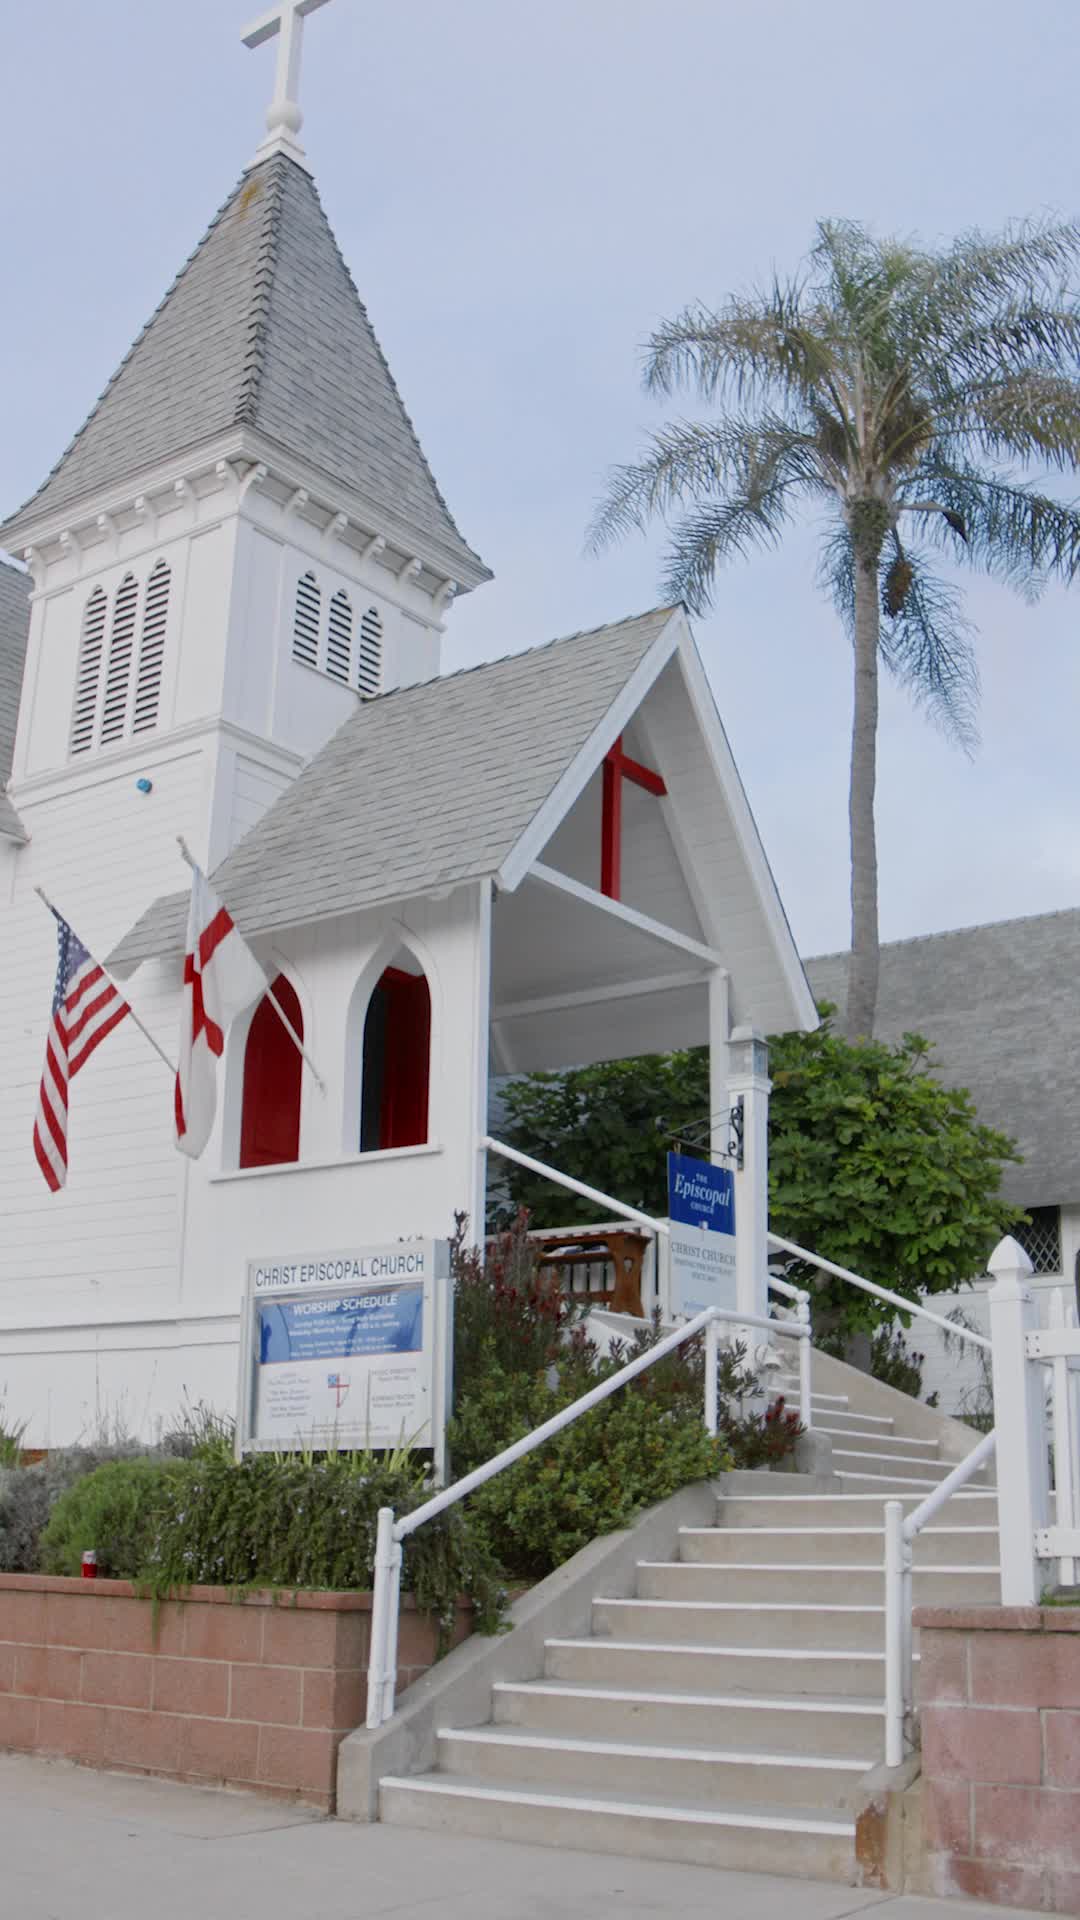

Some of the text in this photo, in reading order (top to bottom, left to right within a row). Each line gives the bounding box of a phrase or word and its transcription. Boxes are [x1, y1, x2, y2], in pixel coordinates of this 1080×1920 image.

[674, 1173, 731, 1207] Episcopal
[671, 1241, 736, 1266] CHRIST CHURCH
[255, 1254, 424, 1287] CHRIST EPISCOPAL CHURCH
[293, 1295, 398, 1315] WORSHIP SCHEDULE
